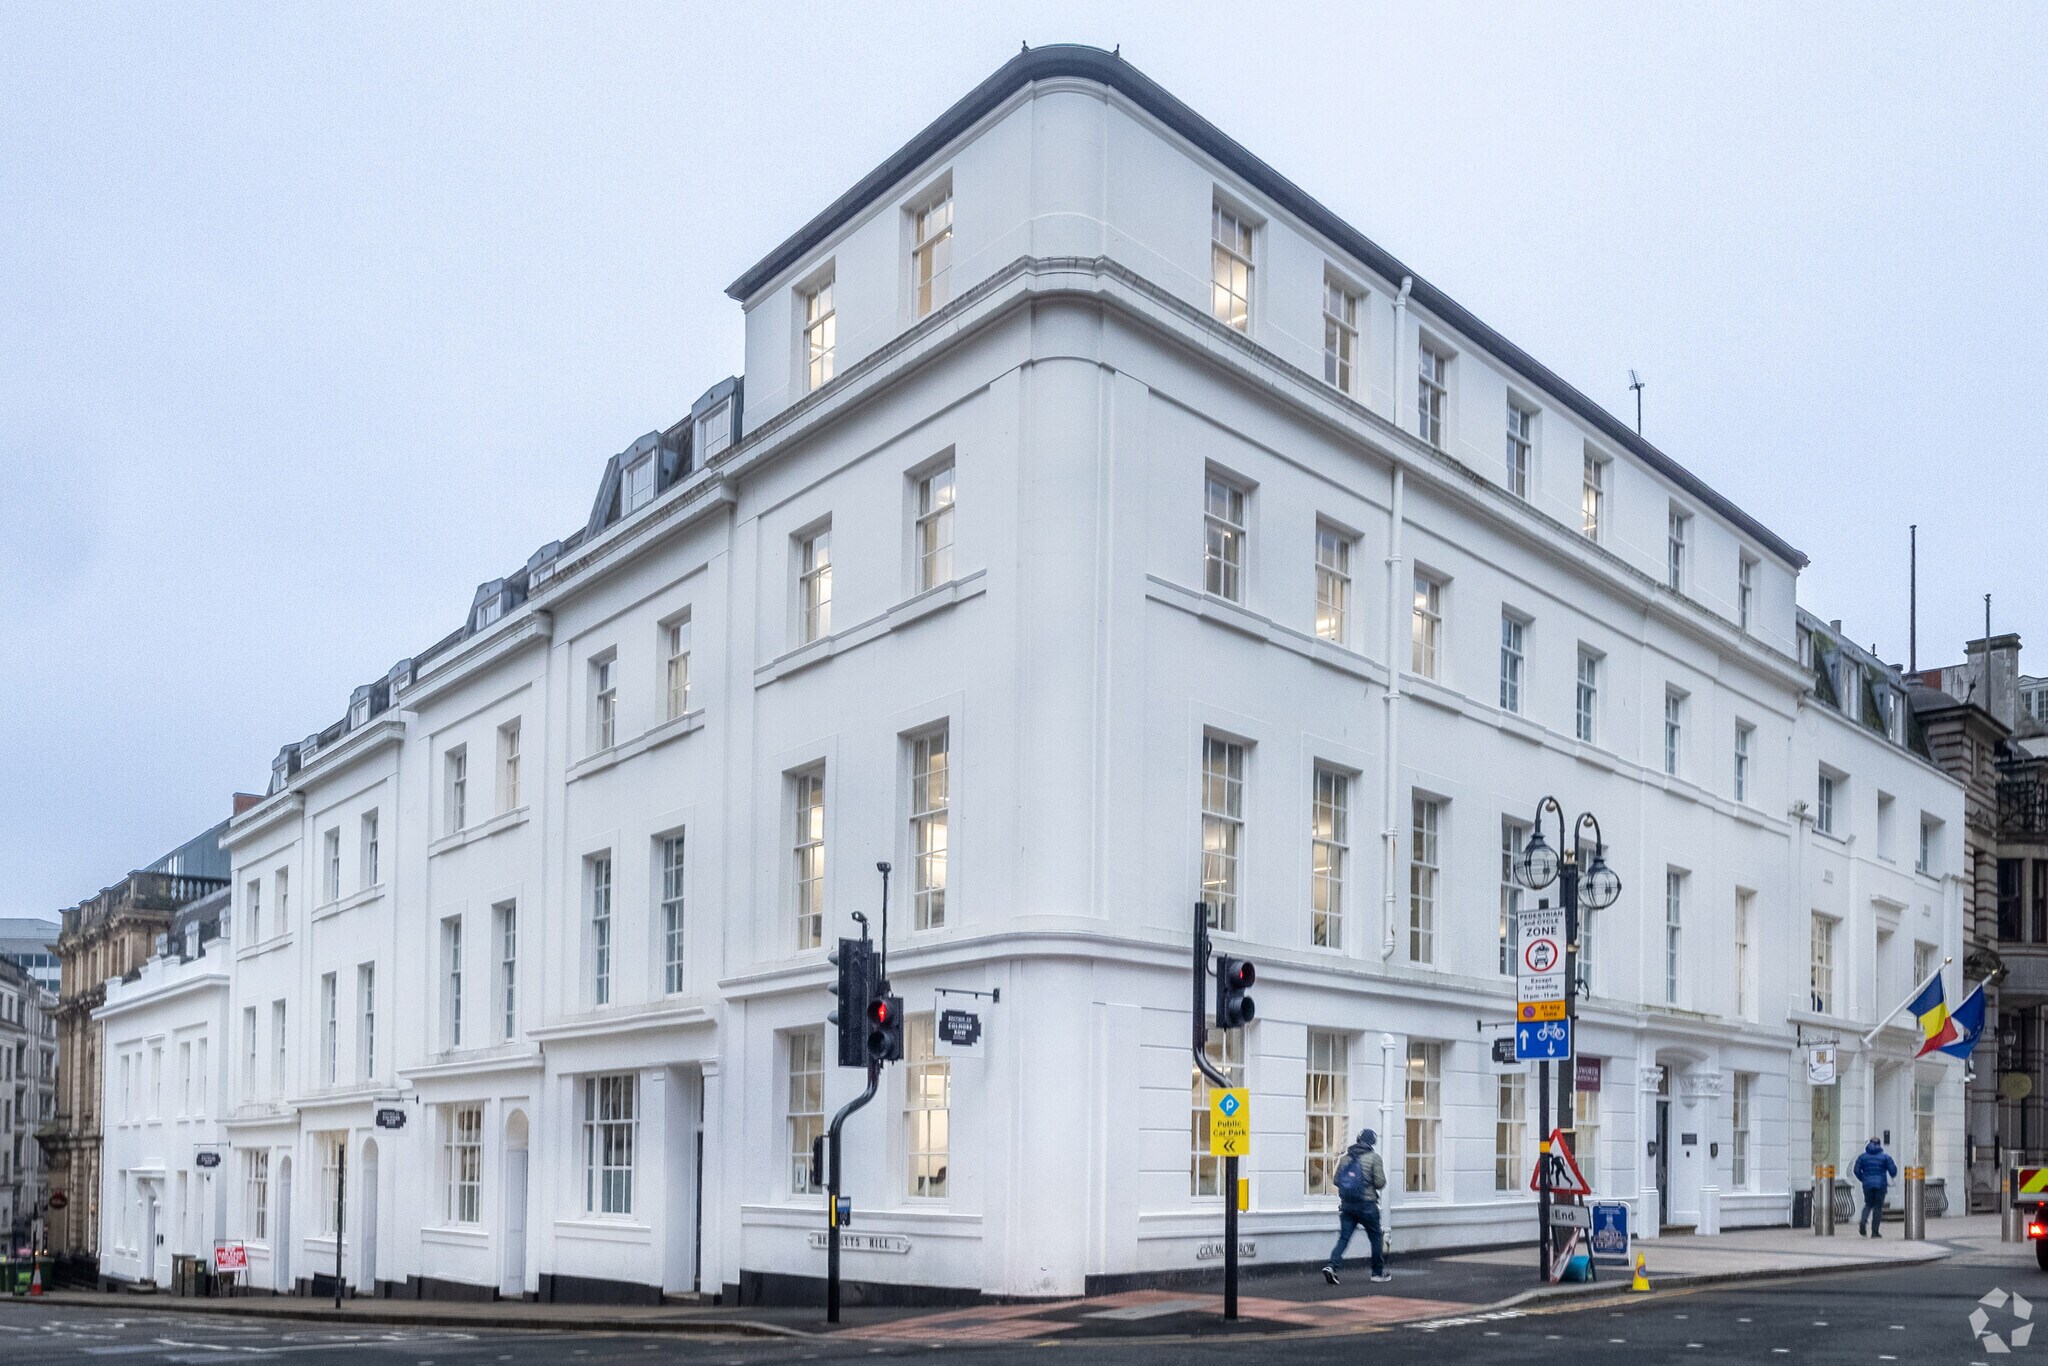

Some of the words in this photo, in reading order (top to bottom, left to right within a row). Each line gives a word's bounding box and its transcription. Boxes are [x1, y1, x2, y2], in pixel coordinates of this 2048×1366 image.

[1519, 911, 1563, 920] PEDESTRIAN
[1538, 918, 1559, 926] CYCLE
[1526, 926, 1557, 937] ZONE
[1213, 1129, 1226, 1137] Car
[1228, 1129, 1247, 1137] Park
[1554, 1209, 1575, 1222] End
[869, 1237, 889, 1249] HILL
[1239, 1242, 1255, 1255] ROW
